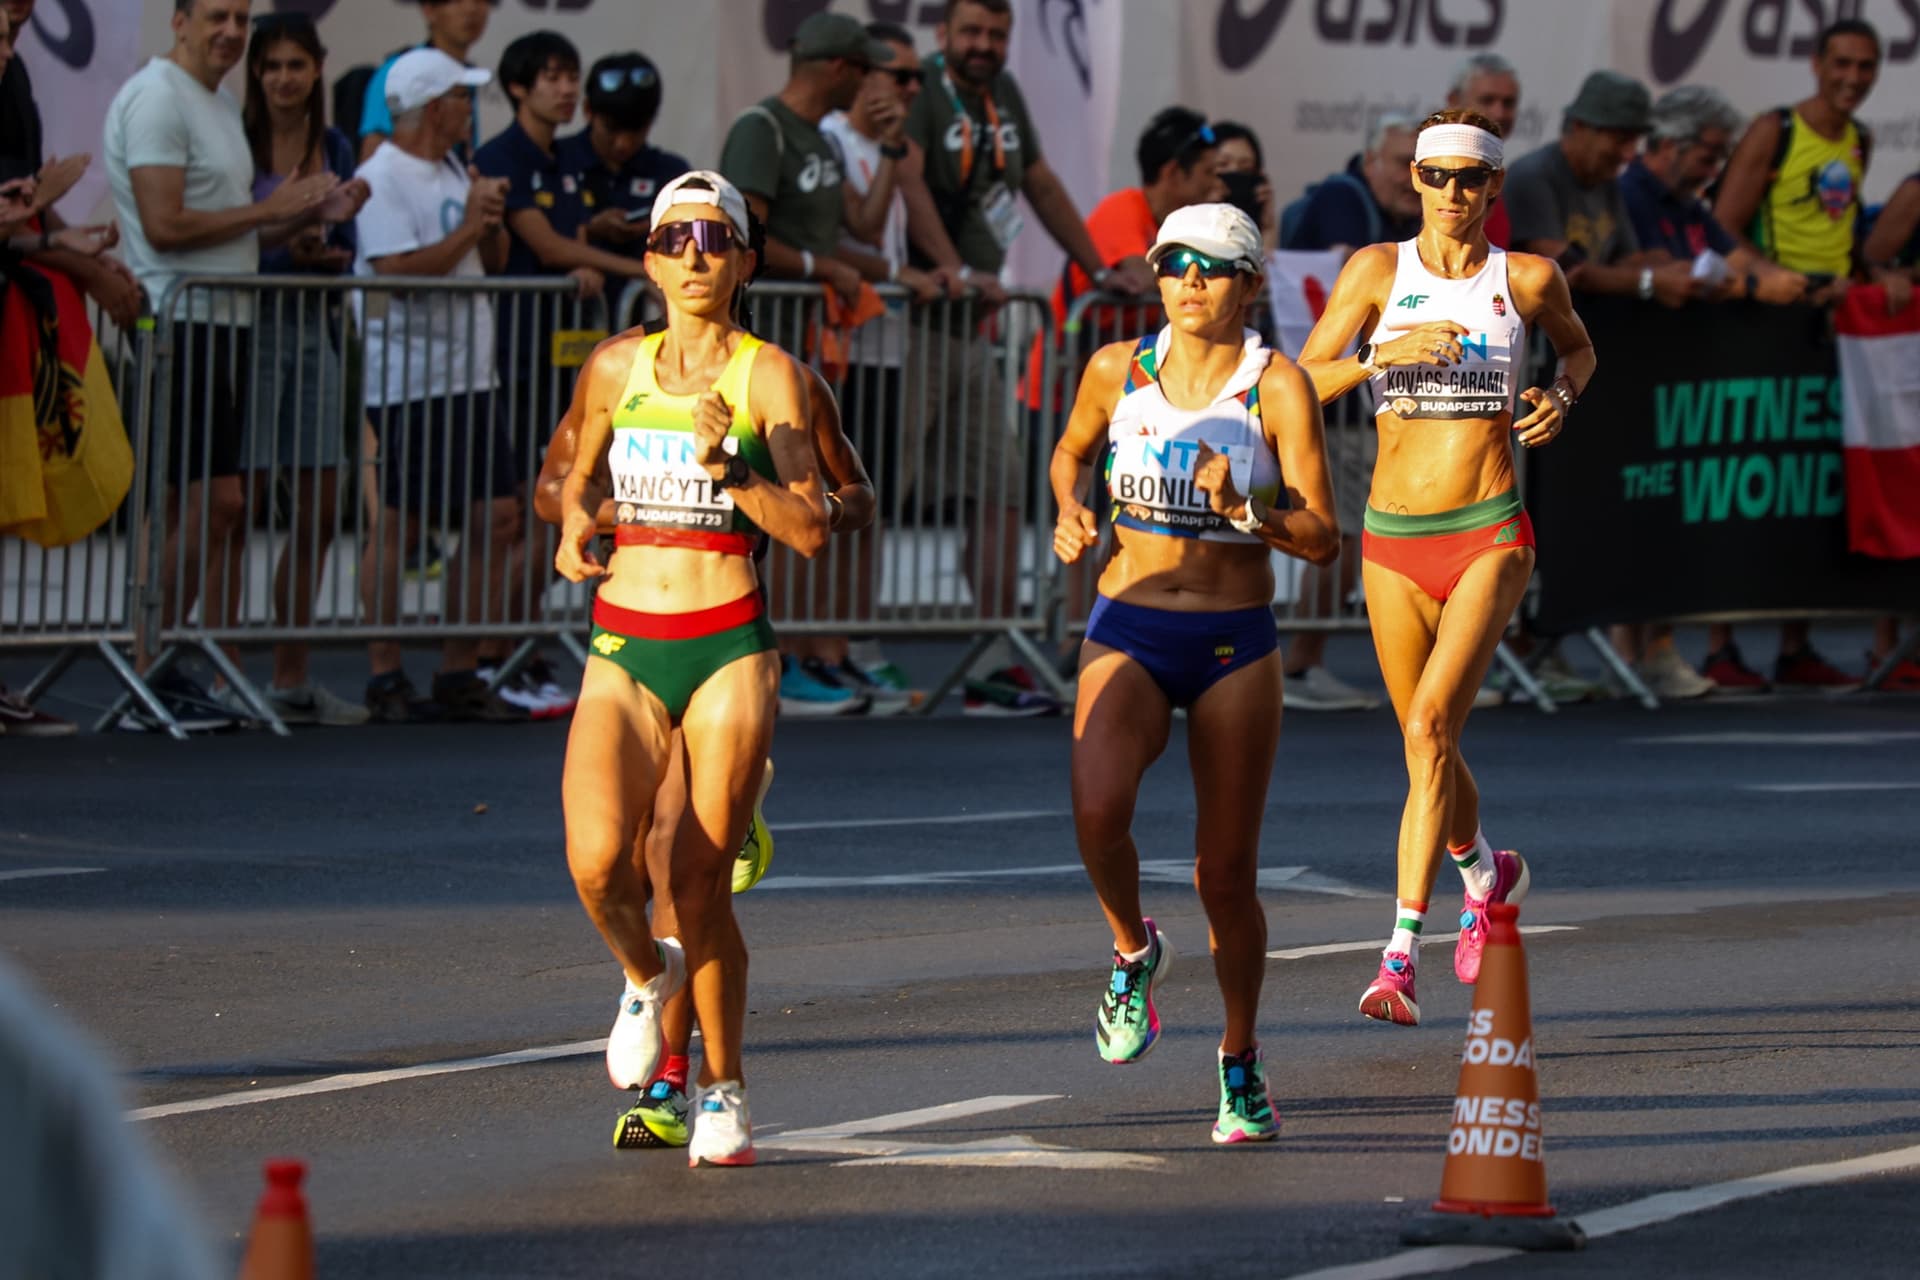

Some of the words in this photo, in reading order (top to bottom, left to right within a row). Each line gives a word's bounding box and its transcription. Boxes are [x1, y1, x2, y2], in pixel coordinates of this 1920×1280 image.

[1387, 367, 1504, 394] KOVÁCS-GARAMI
[1420, 401, 1486, 412] BUDAPEST
[1487, 401, 1502, 411] 23
[1622, 462, 1676, 500] THE
[636, 508, 704, 524] BUDAPEST
[705, 514, 723, 526] 23
